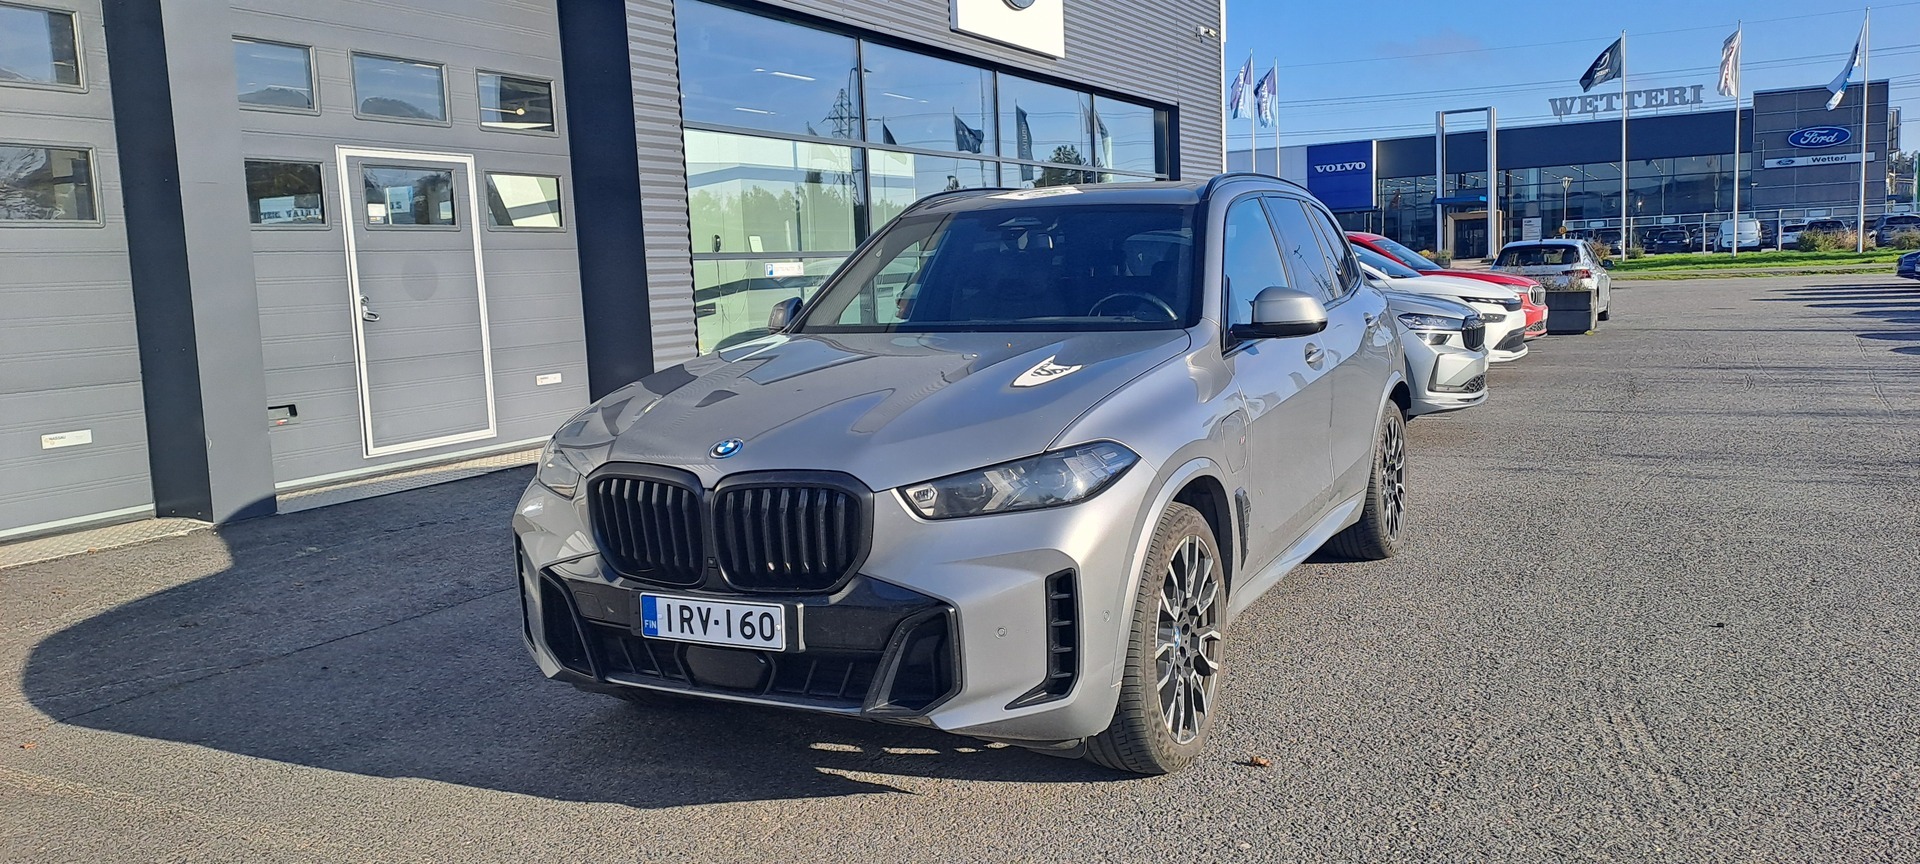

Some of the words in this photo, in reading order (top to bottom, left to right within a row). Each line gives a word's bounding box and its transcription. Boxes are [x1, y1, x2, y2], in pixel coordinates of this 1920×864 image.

[1548, 84, 1704, 116] WETTERI
[1800, 130, 1839, 144] Ford
[1811, 155, 1847, 163] Wetteri
[1314, 161, 1366, 173] VOLVO
[644, 619, 657, 629] FIN
[666, 604, 775, 641] IRV-160
